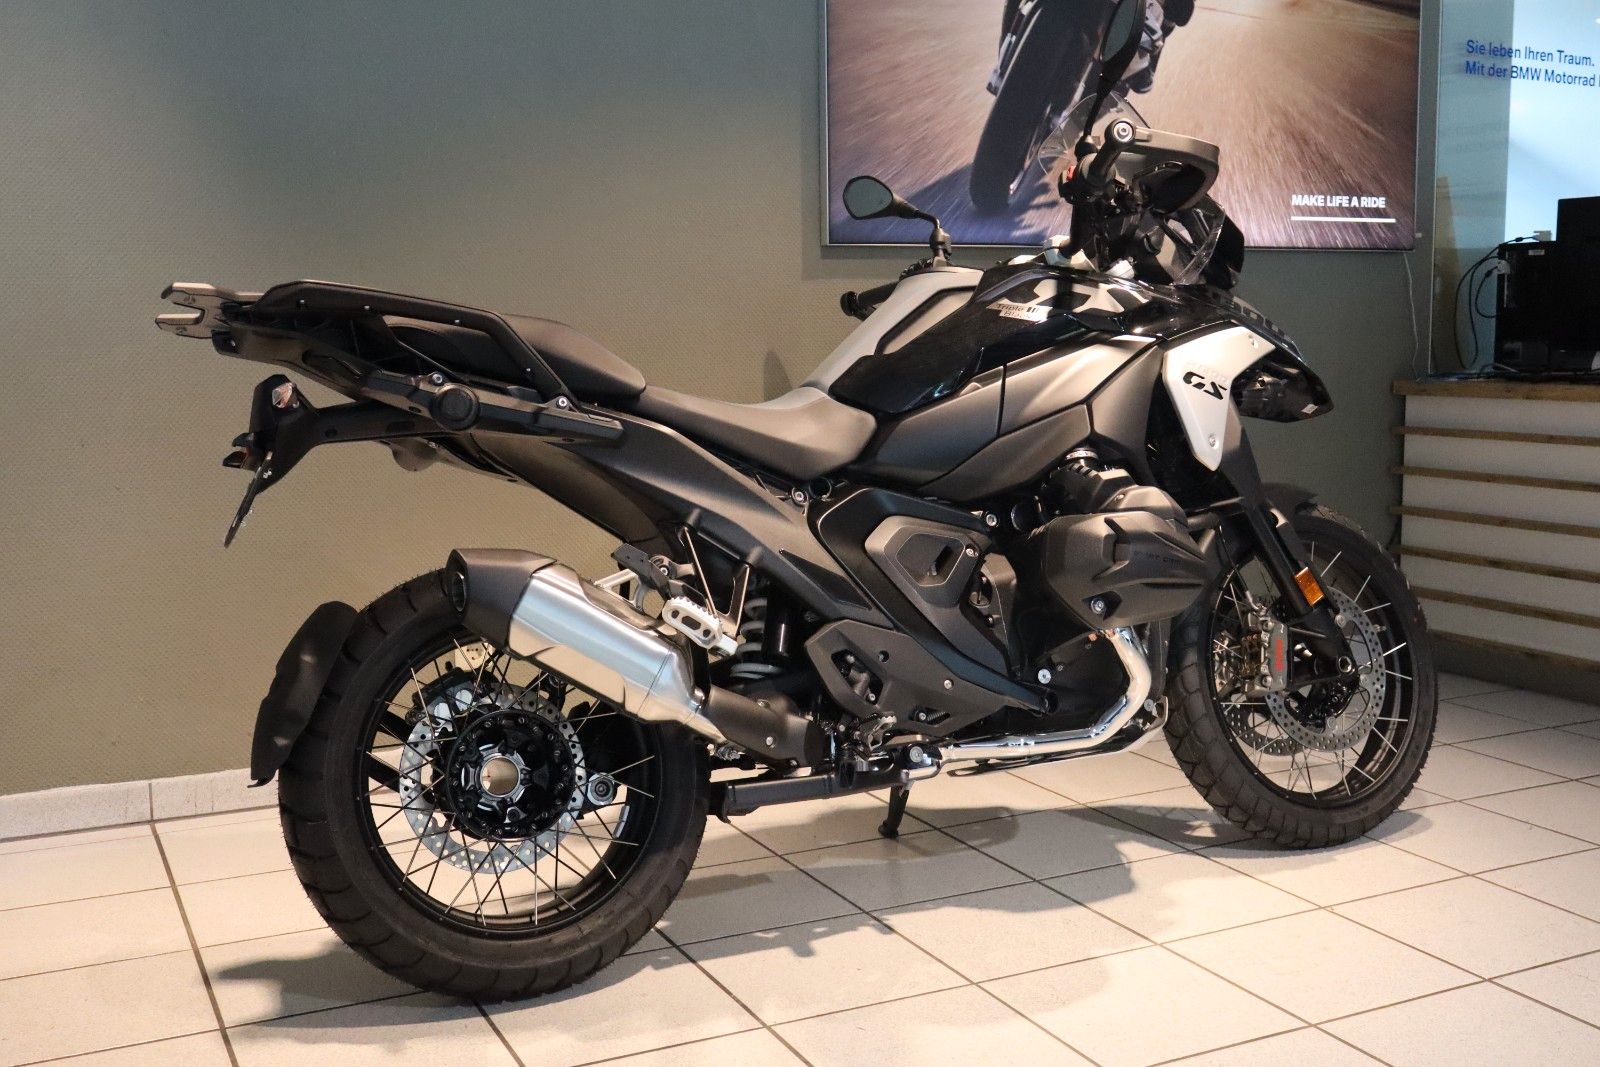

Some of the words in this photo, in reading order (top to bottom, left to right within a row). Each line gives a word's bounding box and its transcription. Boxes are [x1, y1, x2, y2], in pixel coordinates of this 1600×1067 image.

[1466, 40, 1485, 55] Sie
[1488, 42, 1521, 59] leben
[1524, 46, 1554, 62] Ihren
[1556, 50, 1595, 67] Traum.
[1465, 61, 1485, 76] Mit
[1488, 63, 1508, 78] der
[1511, 65, 1541, 81] BMW
[1544, 69, 1596, 87] Motorrad
[1291, 194, 1325, 207] MAKE
[1326, 195, 1349, 207] LIFE
[1350, 196, 1359, 208] A
[1360, 196, 1386, 208] RIDE
